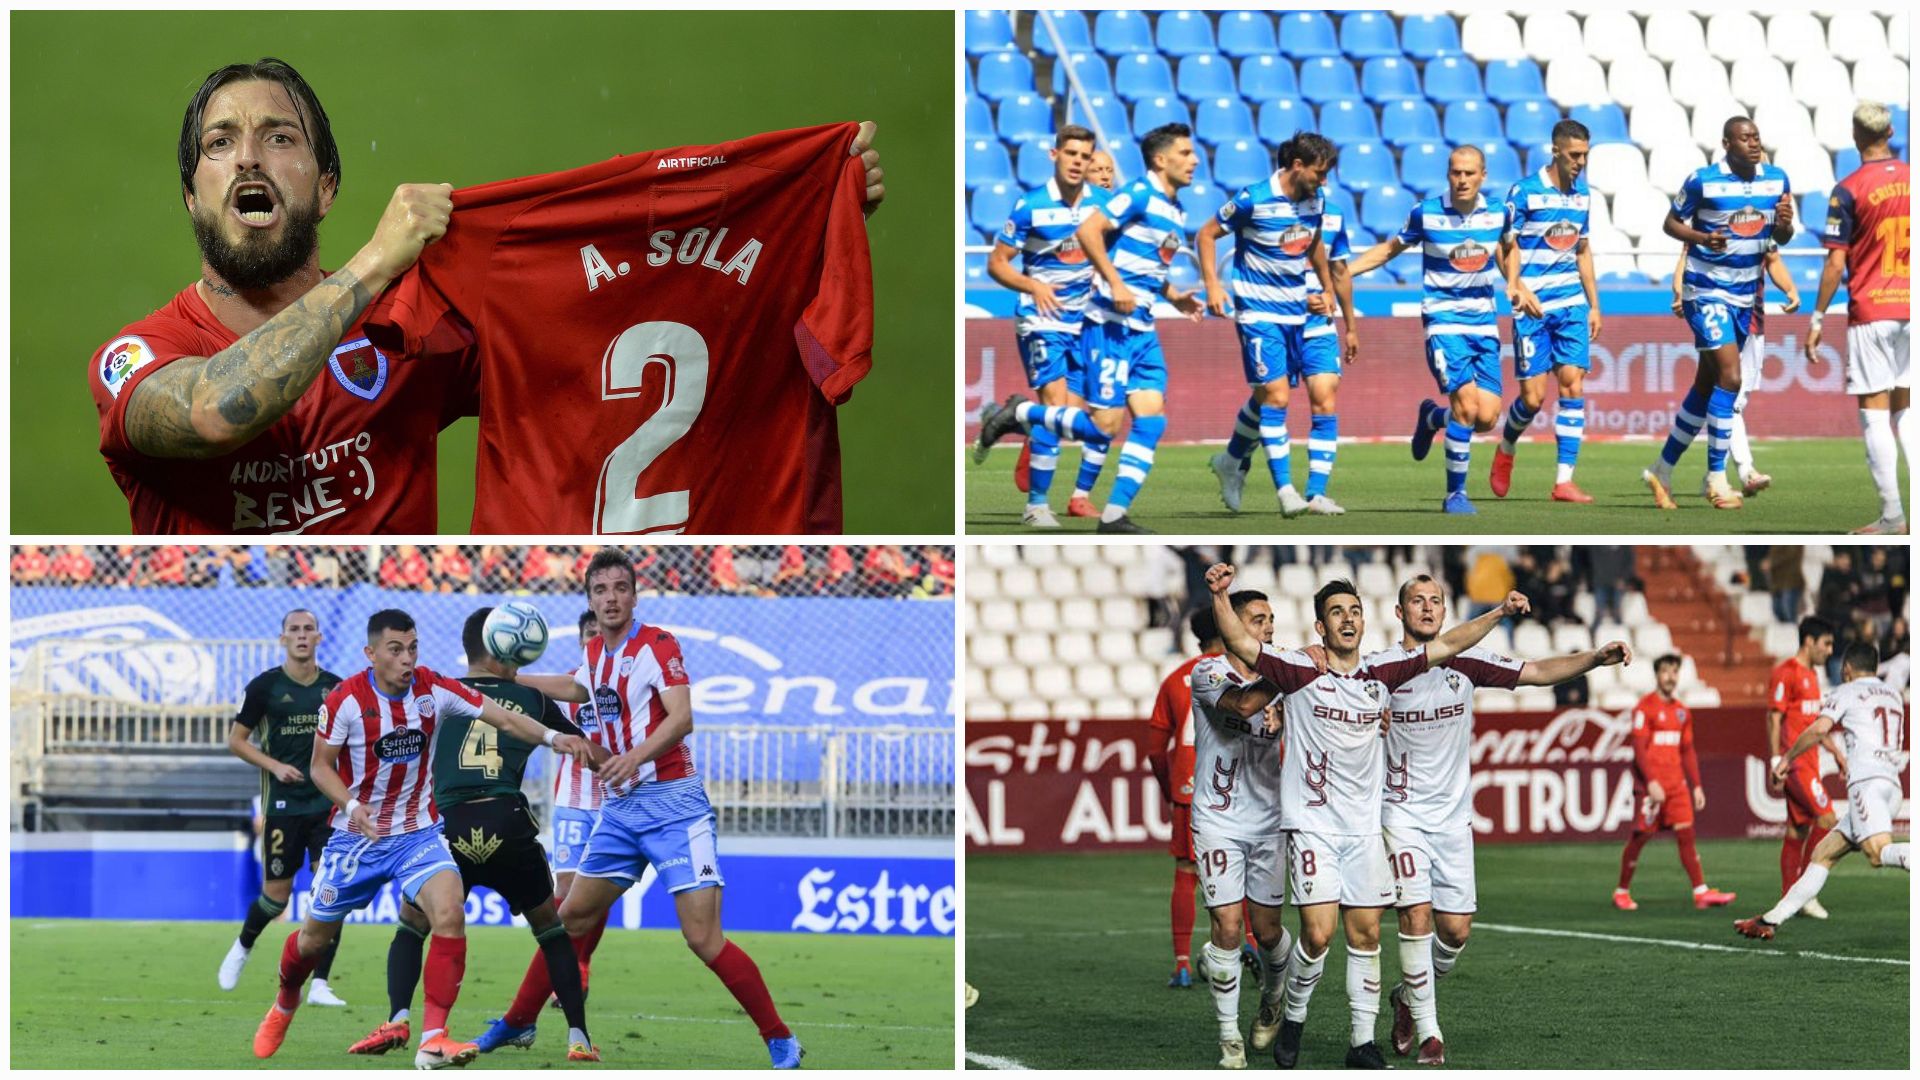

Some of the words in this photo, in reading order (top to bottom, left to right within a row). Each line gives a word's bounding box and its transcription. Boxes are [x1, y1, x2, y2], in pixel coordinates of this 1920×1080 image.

[657, 155, 727, 170] AIRTIFICIAL
[580, 243, 631, 292] A.
[646, 227, 763, 286] SOLA
[1099, 358, 1129, 386] 24
[593, 320, 709, 535] 2
[294, 431, 371, 477] TUTTO
[232, 476, 342, 531] BENE
[288, 714, 318, 725] HERRE
[1392, 703, 1465, 723] SOLISS
[281, 725, 317, 736] BRIGAN
[381, 734, 422, 748] Estrella
[1874, 706, 1903, 751] 17
[382, 744, 420, 758] Galicia
[458, 718, 503, 780] 4
[271, 828, 285, 855] 2
[557, 820, 583, 845] 15
[328, 851, 360, 884] 19
[402, 842, 439, 871] NISSAN
[1202, 849, 1228, 877] 19
[1302, 849, 1317, 877] 8
[1388, 852, 1416, 880] 10
[791, 866, 955, 935] Estre
